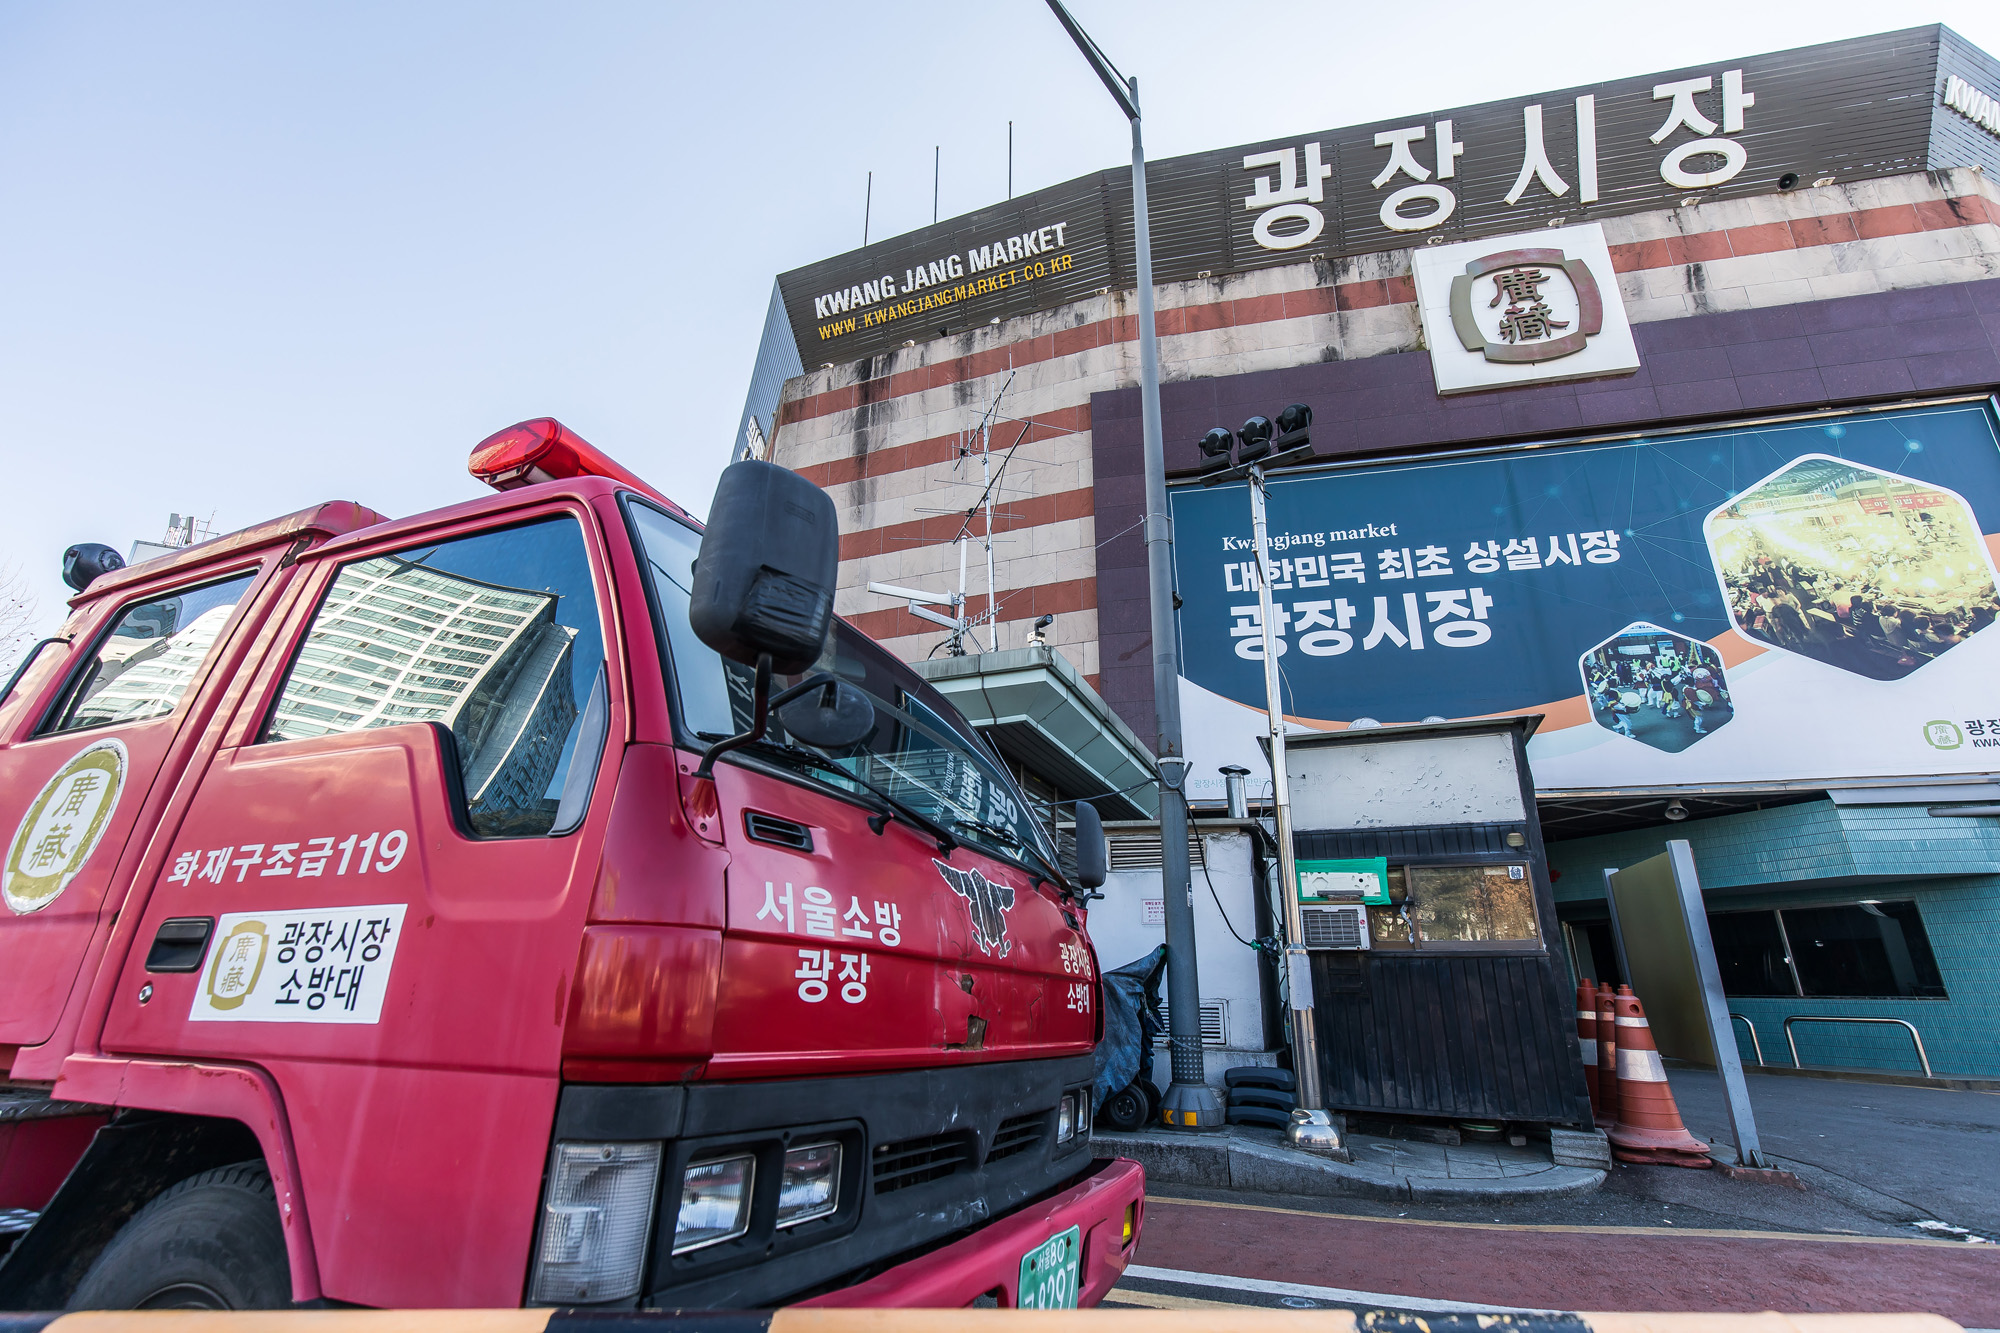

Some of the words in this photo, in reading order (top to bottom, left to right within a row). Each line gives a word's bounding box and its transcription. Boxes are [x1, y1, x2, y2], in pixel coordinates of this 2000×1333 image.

[1243, 69, 1755, 251] 광장시장
[815, 275, 897, 319] KWANG
[901, 254, 964, 294] JANG
[968, 222, 1067, 274] MARKET
[1329, 523, 1398, 543] market
[1224, 552, 1366, 592] 대한민국
[1377, 545, 1454, 580] 최초
[1464, 530, 1621, 573] 상설시장
[1230, 587, 1494, 661] 광장시장
[1246, 777, 1270, 787] 한민국
[166, 829, 409, 888] 화재구조급119
[277, 917, 391, 964] 광장시장
[755, 881, 902, 947] 서울소방
[794, 949, 871, 1004] 광장
[1059, 942, 1092, 977] 광장시장
[275, 965, 365, 1011] 소방대
[1067, 983, 1090, 1014] 소방대
